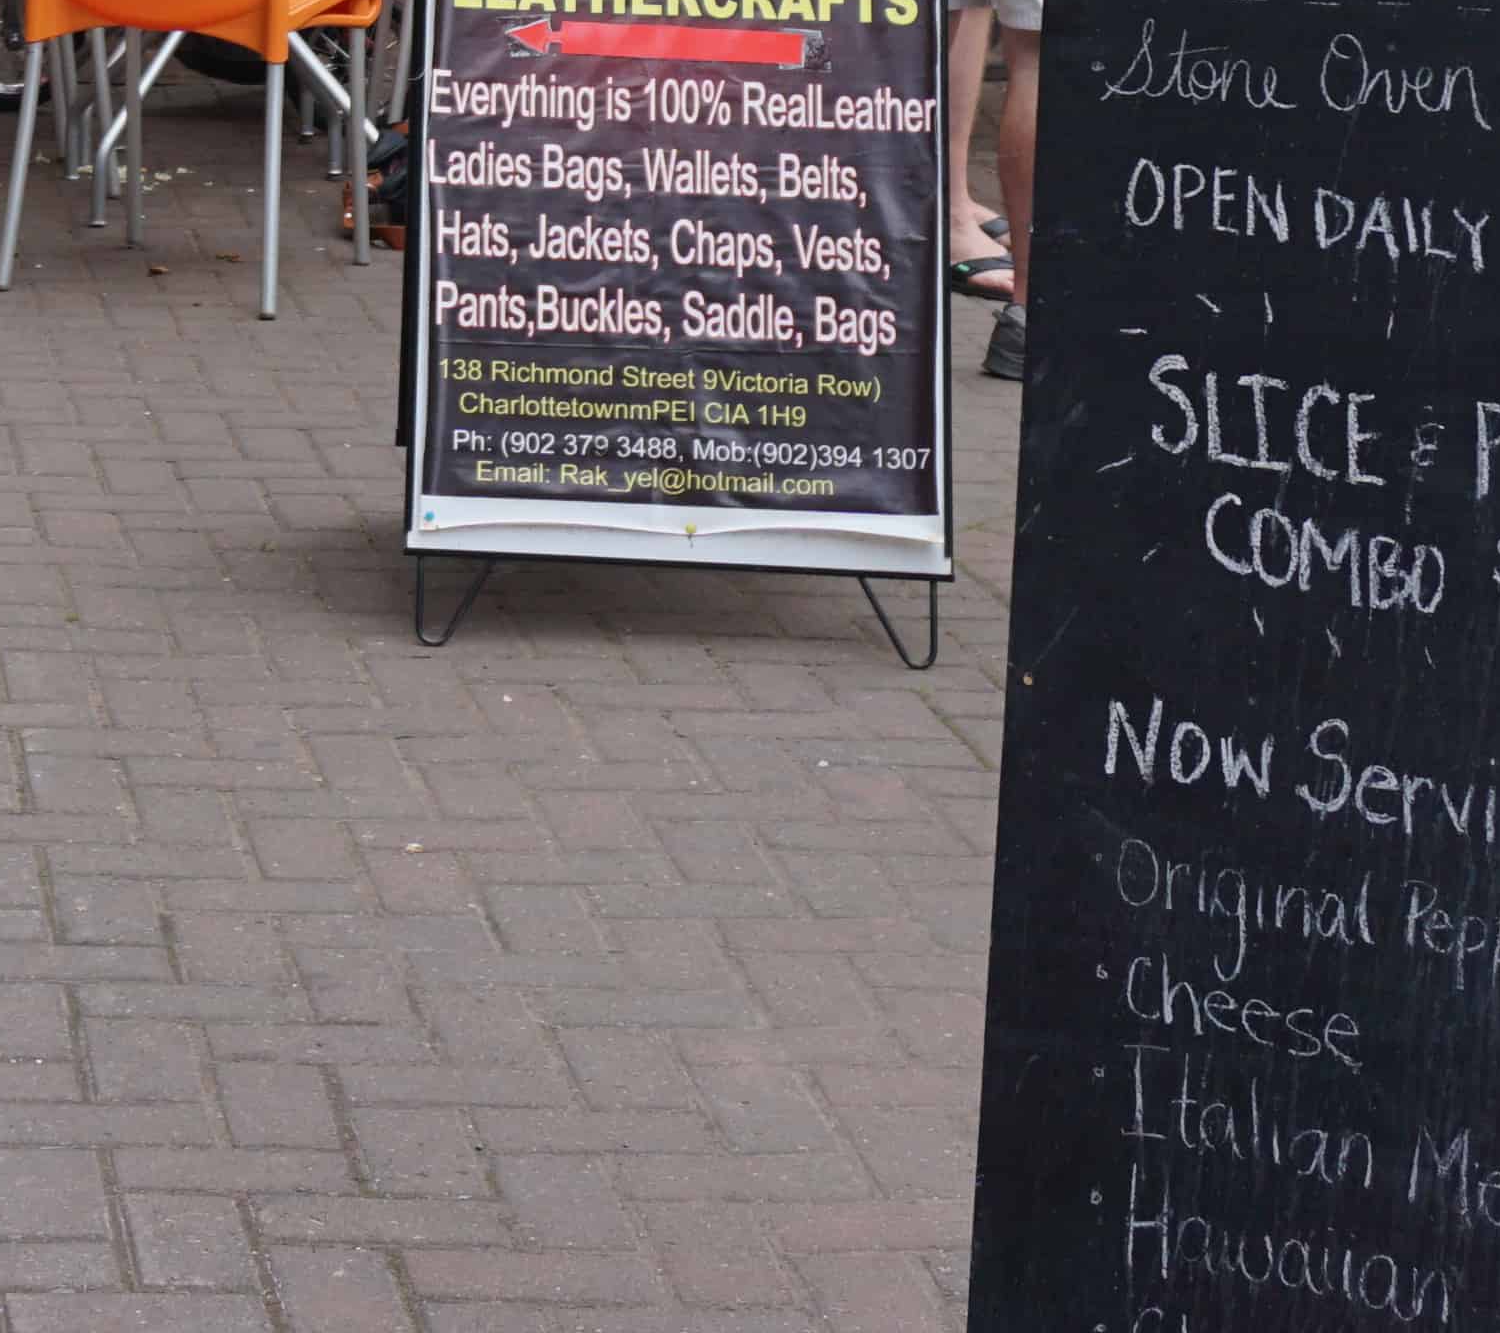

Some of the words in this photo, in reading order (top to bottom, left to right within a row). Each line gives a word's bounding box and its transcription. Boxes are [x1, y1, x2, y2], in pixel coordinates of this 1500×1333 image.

[430, 68, 596, 132] Everything
[606, 76, 632, 122] is
[643, 78, 732, 126] 100%
[1101, 17, 1299, 111] Stone
[1319, 33, 1492, 131] Oven
[428, 139, 533, 189] Ladies
[542, 143, 632, 203] Bags,
[641, 147, 768, 205] Wallets,
[778, 152, 868, 209] Belts,
[1124, 157, 1290, 245] OPEN
[1314, 184, 1490, 275] DAILY
[436, 209, 519, 265] Hats,
[529, 213, 660, 271] Jackets,
[671, 218, 784, 278] Chaps,
[792, 223, 892, 281] Vests,
[682, 290, 804, 349] Saddle,
[814, 295, 898, 357] Bags
[439, 358, 483, 382] 138
[490, 360, 615, 387] Richmond
[622, 365, 697, 391] Street
[703, 368, 810, 396] 9Victoria
[817, 373, 883, 404] Row)
[459, 391, 697, 423] CharlottetownmPEI
[757, 405, 808, 428] 1H9
[1148, 353, 1387, 488] SLICE
[452, 429, 494, 453] Ph:
[501, 431, 556, 458] (902
[563, 434, 609, 457] 379
[616, 436, 685, 463] 3488,
[873, 447, 932, 470] 1307
[475, 460, 551, 485] Email:
[559, 463, 835, 496] Rak_yel@hotmail.com
[1204, 491, 1447, 614] COMBO
[1103, 697, 1275, 799] Now
[1115, 837, 1377, 982] Original
[1122, 1044, 1374, 1192] Italian
[1124, 1159, 1452, 1325] Hawaiian
